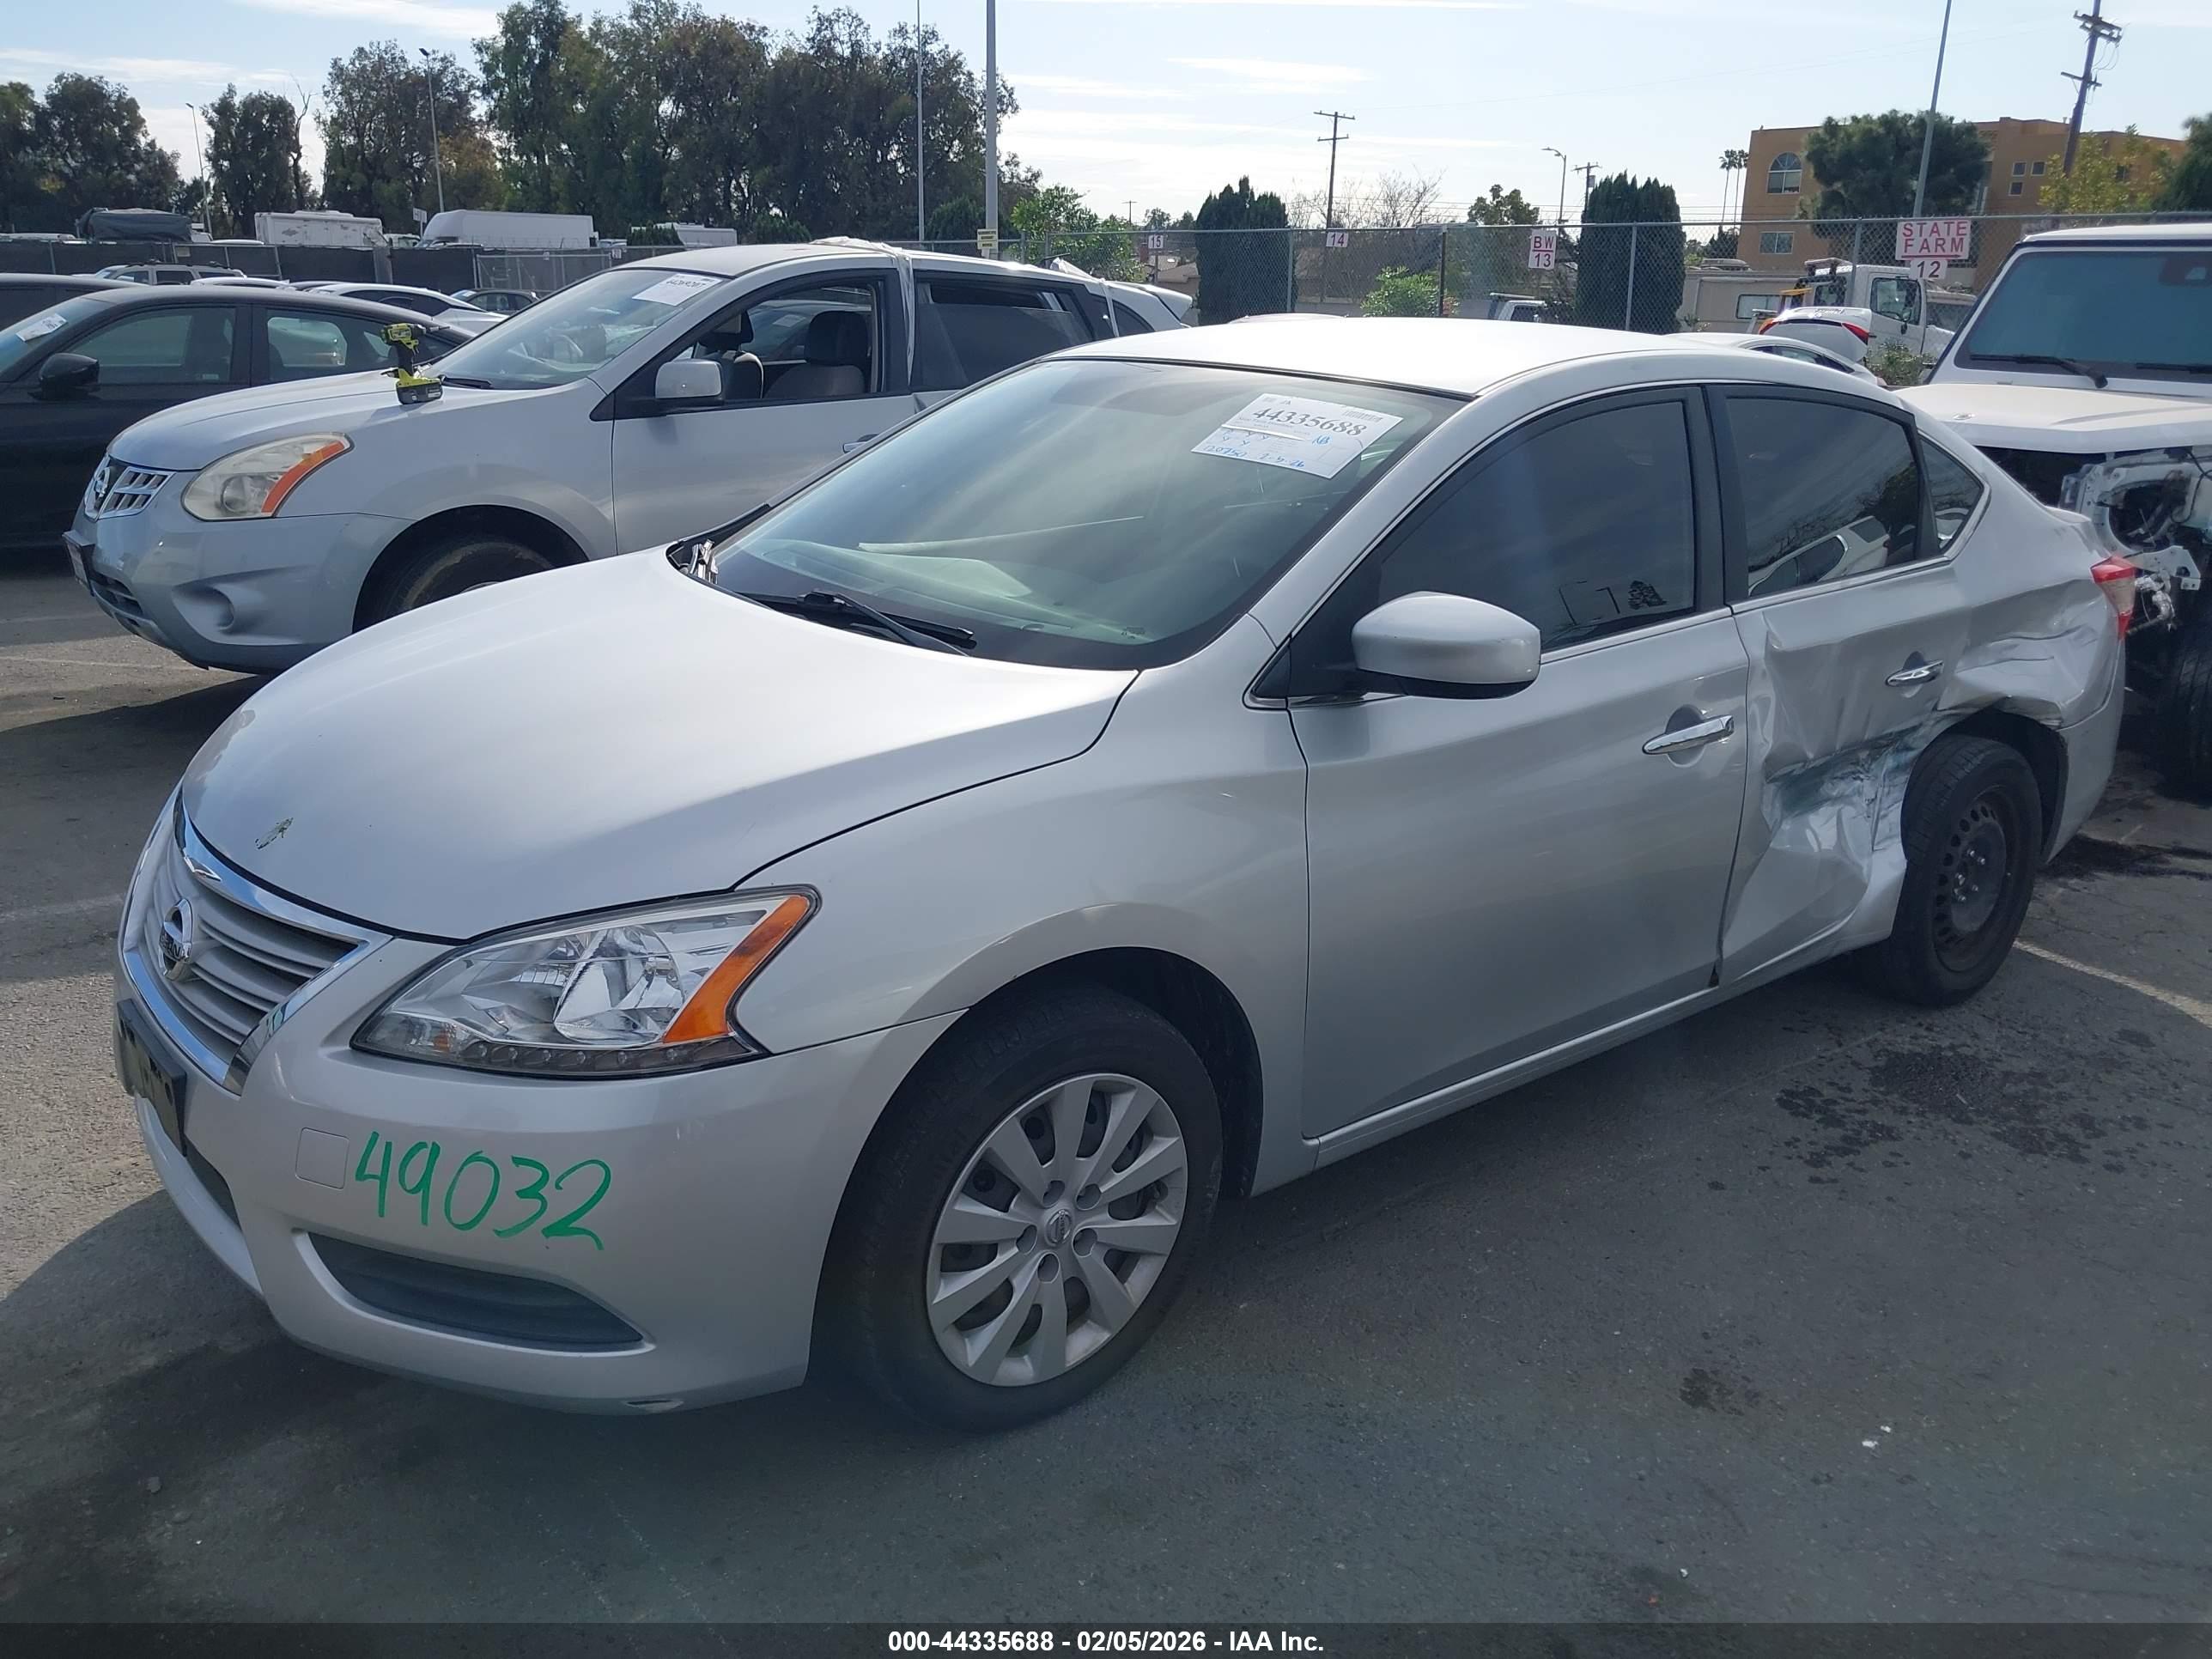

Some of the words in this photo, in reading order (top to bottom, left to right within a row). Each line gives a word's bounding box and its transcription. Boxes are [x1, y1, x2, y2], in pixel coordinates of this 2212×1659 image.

[1902, 221, 1968, 237] STATE
[1151, 235, 1162, 248] 15
[1329, 233, 1346, 246] 14
[1534, 235, 1553, 249] BW
[1904, 238, 1965, 253] FARM
[1534, 252, 1551, 267] 13
[1917, 261, 1941, 278] 12
[1253, 408, 1368, 436] 44335688
[355, 1131, 611, 1250] 49032
